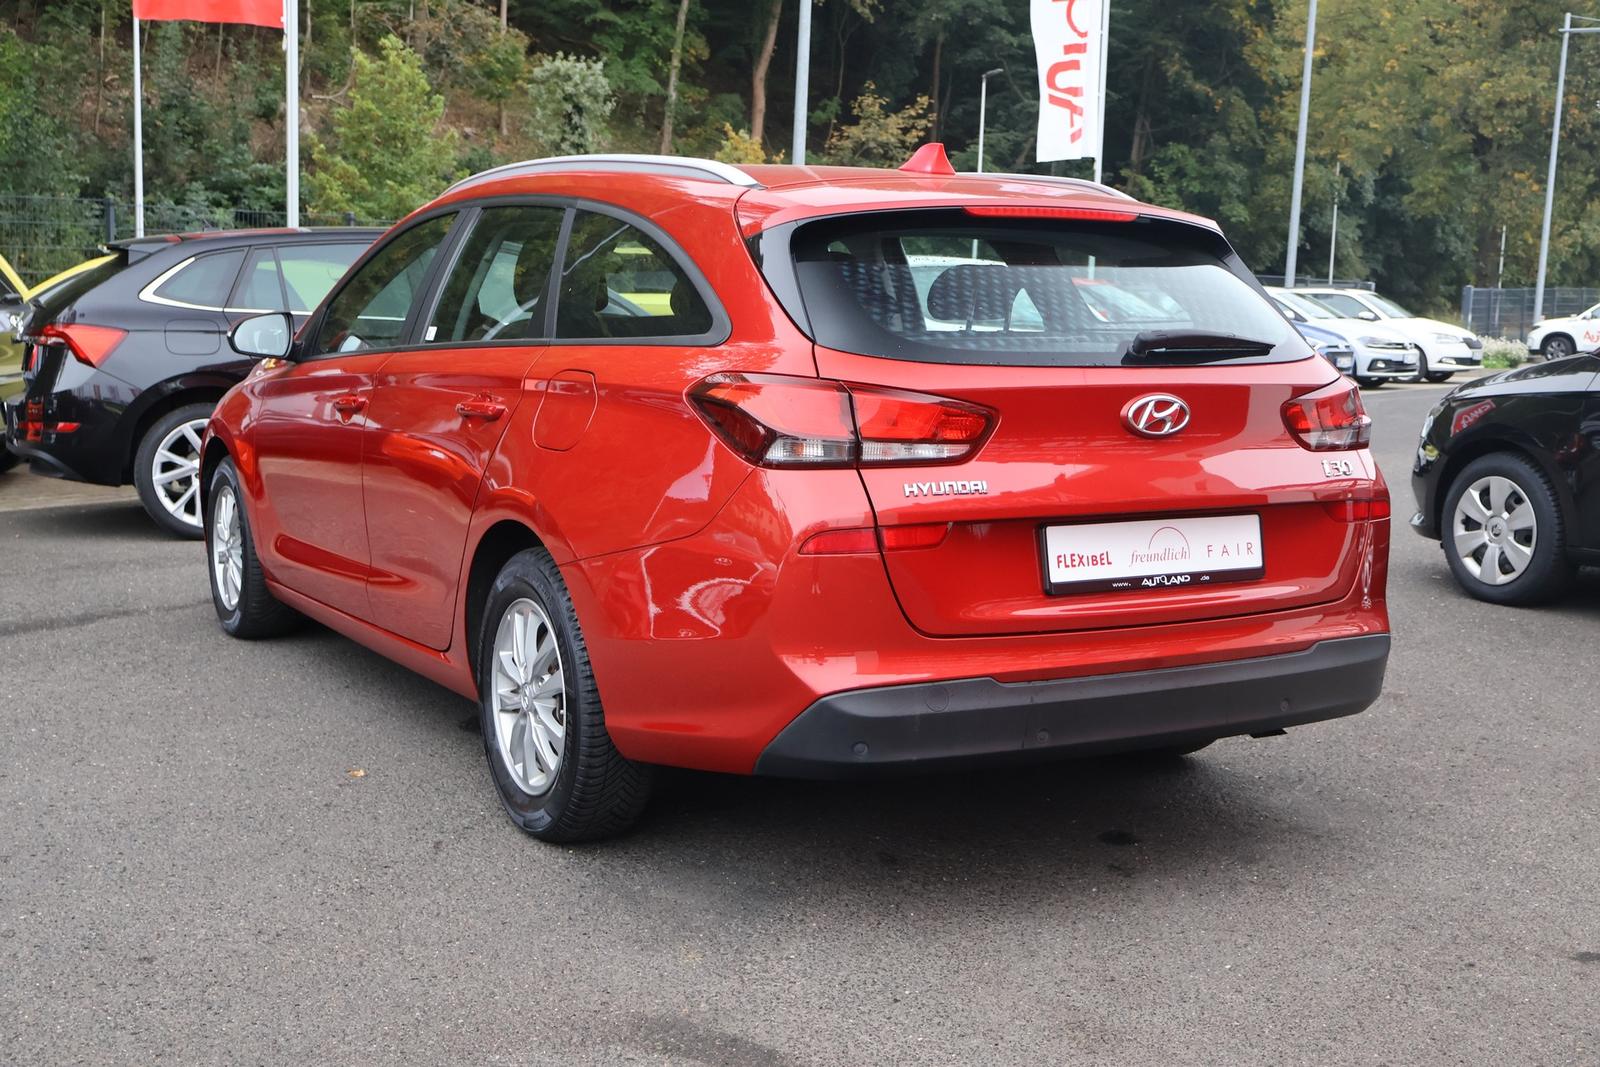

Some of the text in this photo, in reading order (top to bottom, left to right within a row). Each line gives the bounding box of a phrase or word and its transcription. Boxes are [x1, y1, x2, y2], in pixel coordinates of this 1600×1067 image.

[1321, 459, 1353, 477] i30
[903, 480, 988, 497] HYUNDAI
[1056, 550, 1112, 569] FLEXIBEL
[1128, 546, 1188, 568] freundlich
[1141, 575, 1191, 587] AUTOLAND
